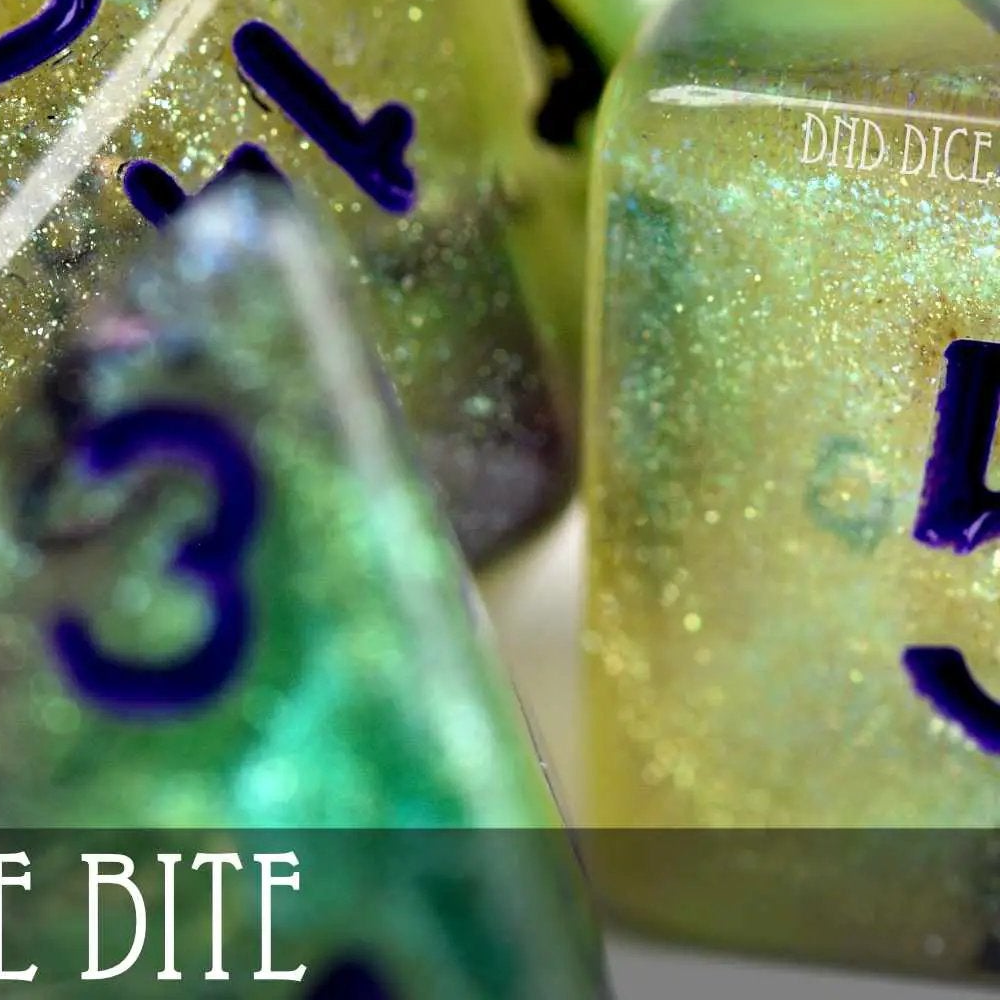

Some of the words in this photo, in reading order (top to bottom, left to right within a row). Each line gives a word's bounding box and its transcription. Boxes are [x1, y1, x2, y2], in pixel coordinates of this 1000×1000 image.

[800, 112, 885, 171] DND
[901, 123, 993, 186] DICE
[54, 402, 266, 718] 3
